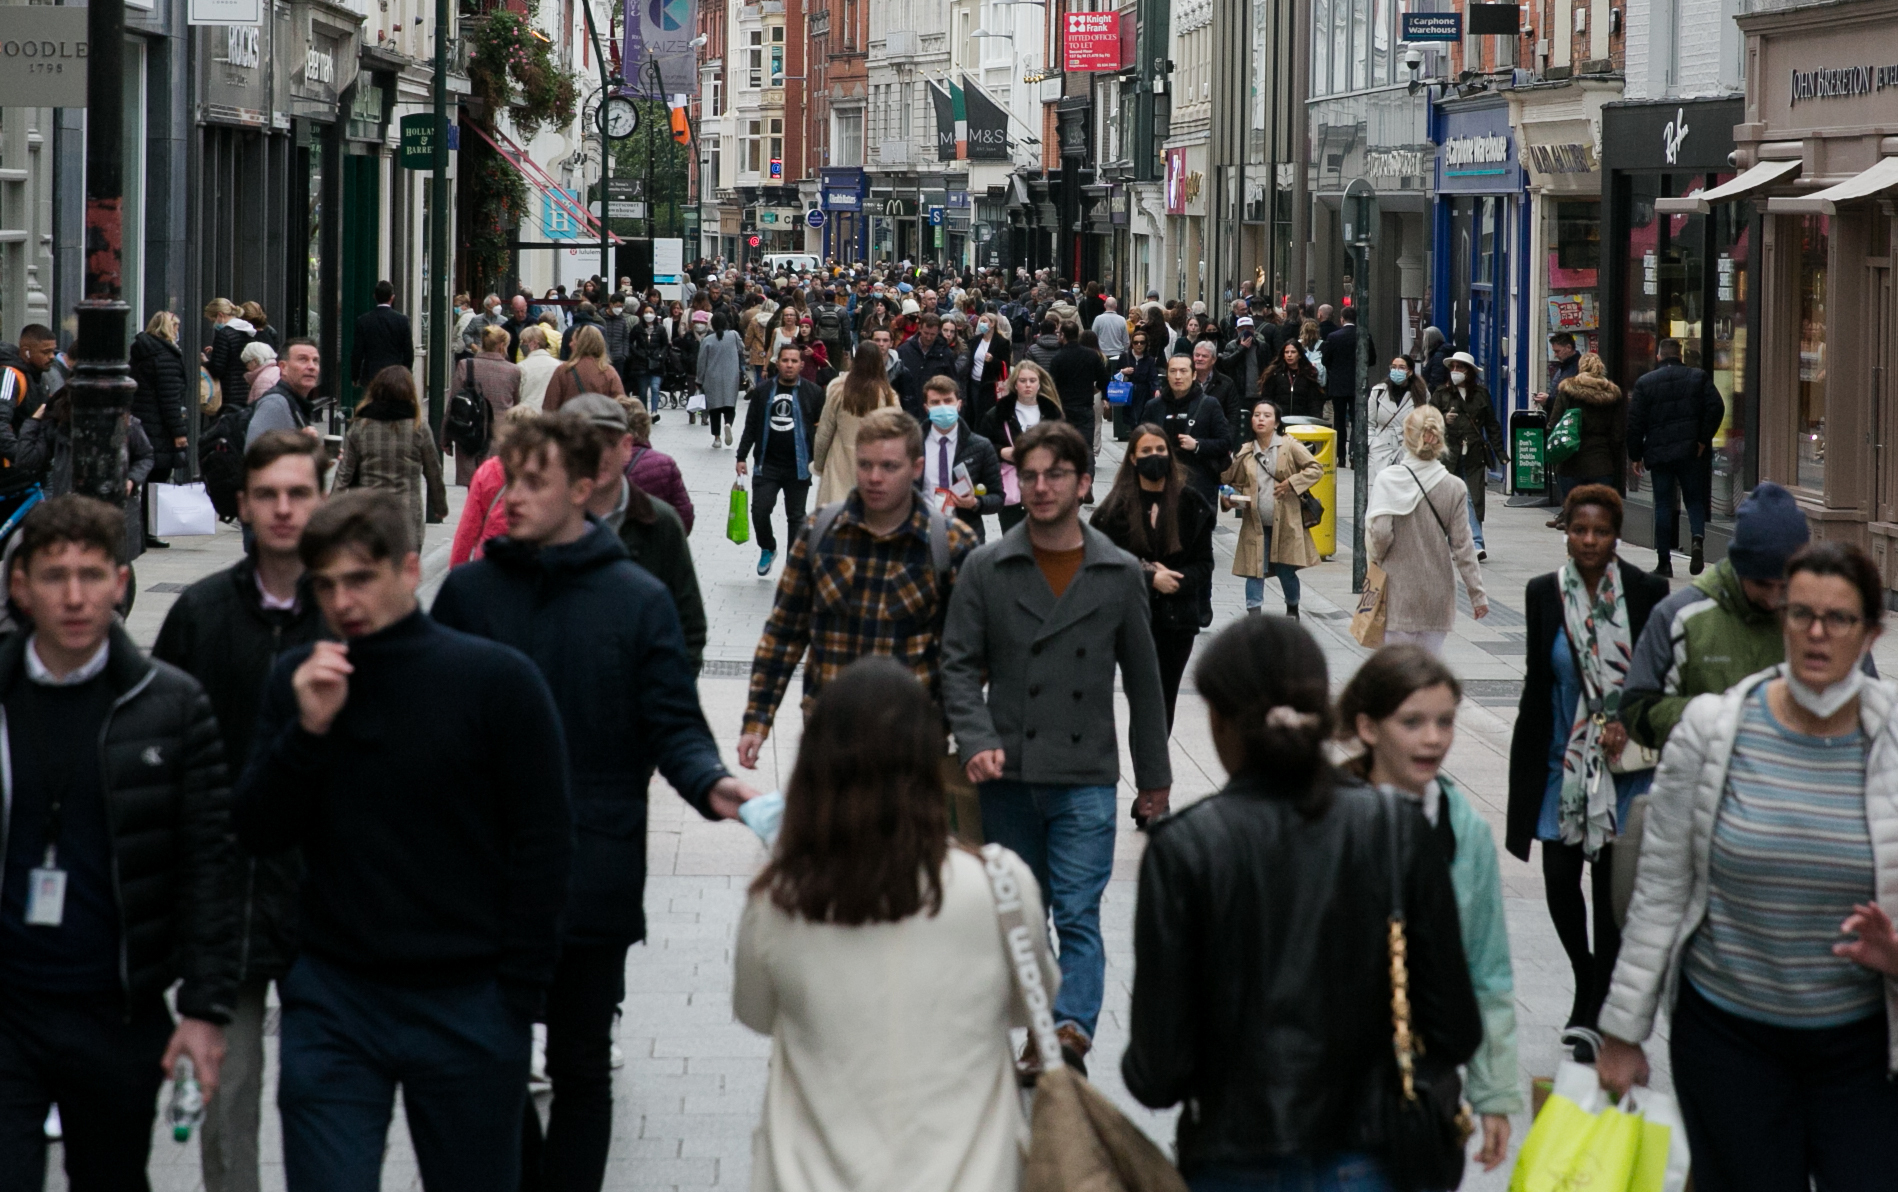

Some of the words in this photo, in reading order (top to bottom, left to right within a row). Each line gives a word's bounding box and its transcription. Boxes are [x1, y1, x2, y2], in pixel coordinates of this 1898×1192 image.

[1086, 15, 1112, 25] Knight
[1413, 17, 1455, 25] Carphone
[1086, 24, 1108, 32] Frank
[1408, 26, 1457, 34] Warehouse
[1068, 34, 1090, 42] FITTED
[1091, 33, 1117, 41] OFFICES
[228, 25, 260, 70] ROCKS
[641, 40, 695, 53] KAIZEN
[1789, 68, 1816, 108] JOHN
[1817, 66, 1872, 97] BRERETON
[420, 136, 428, 145] &
[969, 128, 1004, 144] M&S
[1474, 130, 1507, 163] Warehouse
